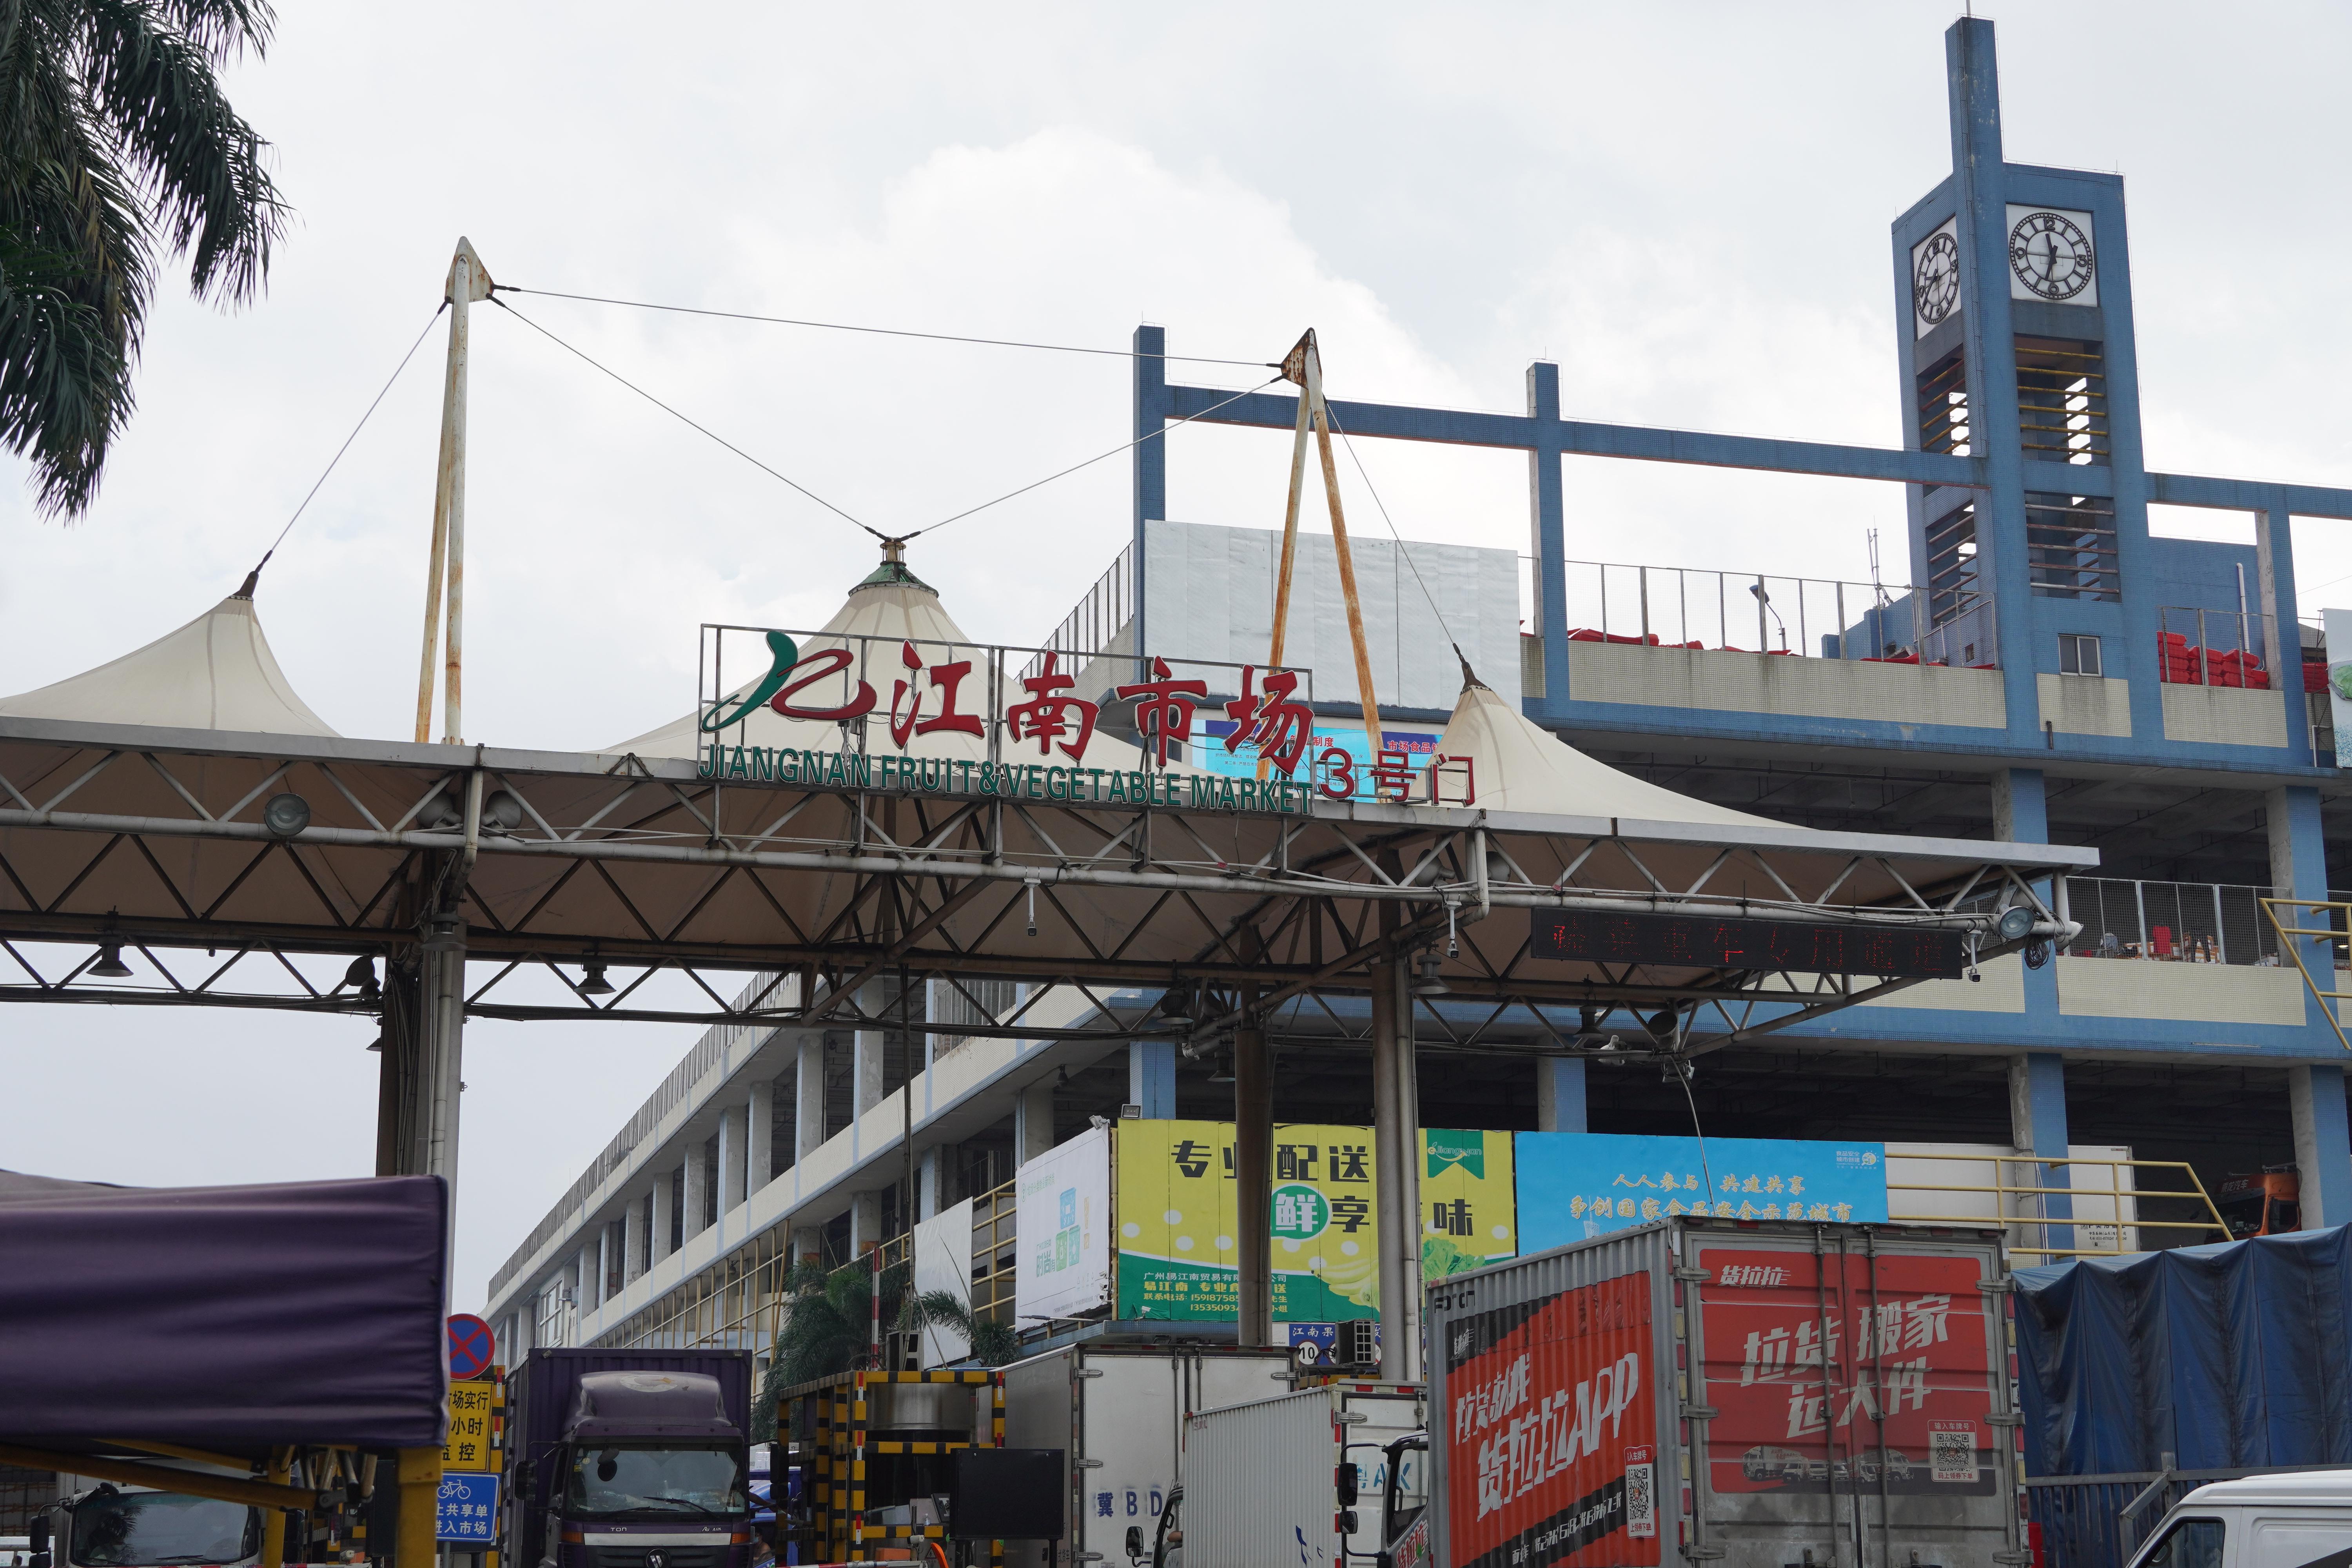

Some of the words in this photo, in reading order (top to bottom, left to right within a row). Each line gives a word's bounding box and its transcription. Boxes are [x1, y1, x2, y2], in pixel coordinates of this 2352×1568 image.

[2043, 218, 2055, 230] 12
[2015, 247, 2026, 259] 9
[2077, 254, 2087, 267] 3
[2048, 282, 2059, 295] 6
[889, 639, 1315, 776] 江南市场
[699, 743, 871, 788] JIANGNAN
[1191, 774, 1314, 815] MARKET
[1318, 747, 1475, 808] 3号门
[1612, 1171, 1699, 1192] 人人参与
[1719, 1174, 1806, 1196] 共建共享
[1275, 1193, 1473, 1236] 鲜享味
[1199, 1282, 1287, 1293] 专业食送
[1717, 1265, 1788, 1289] 货拉拉
[1300, 1347, 1315, 1360] 10
[1740, 1316, 1841, 1387] 拉货
[1786, 1356, 1933, 1439] 运大件
[1934, 1422, 1969, 1430] 输入车牌号
